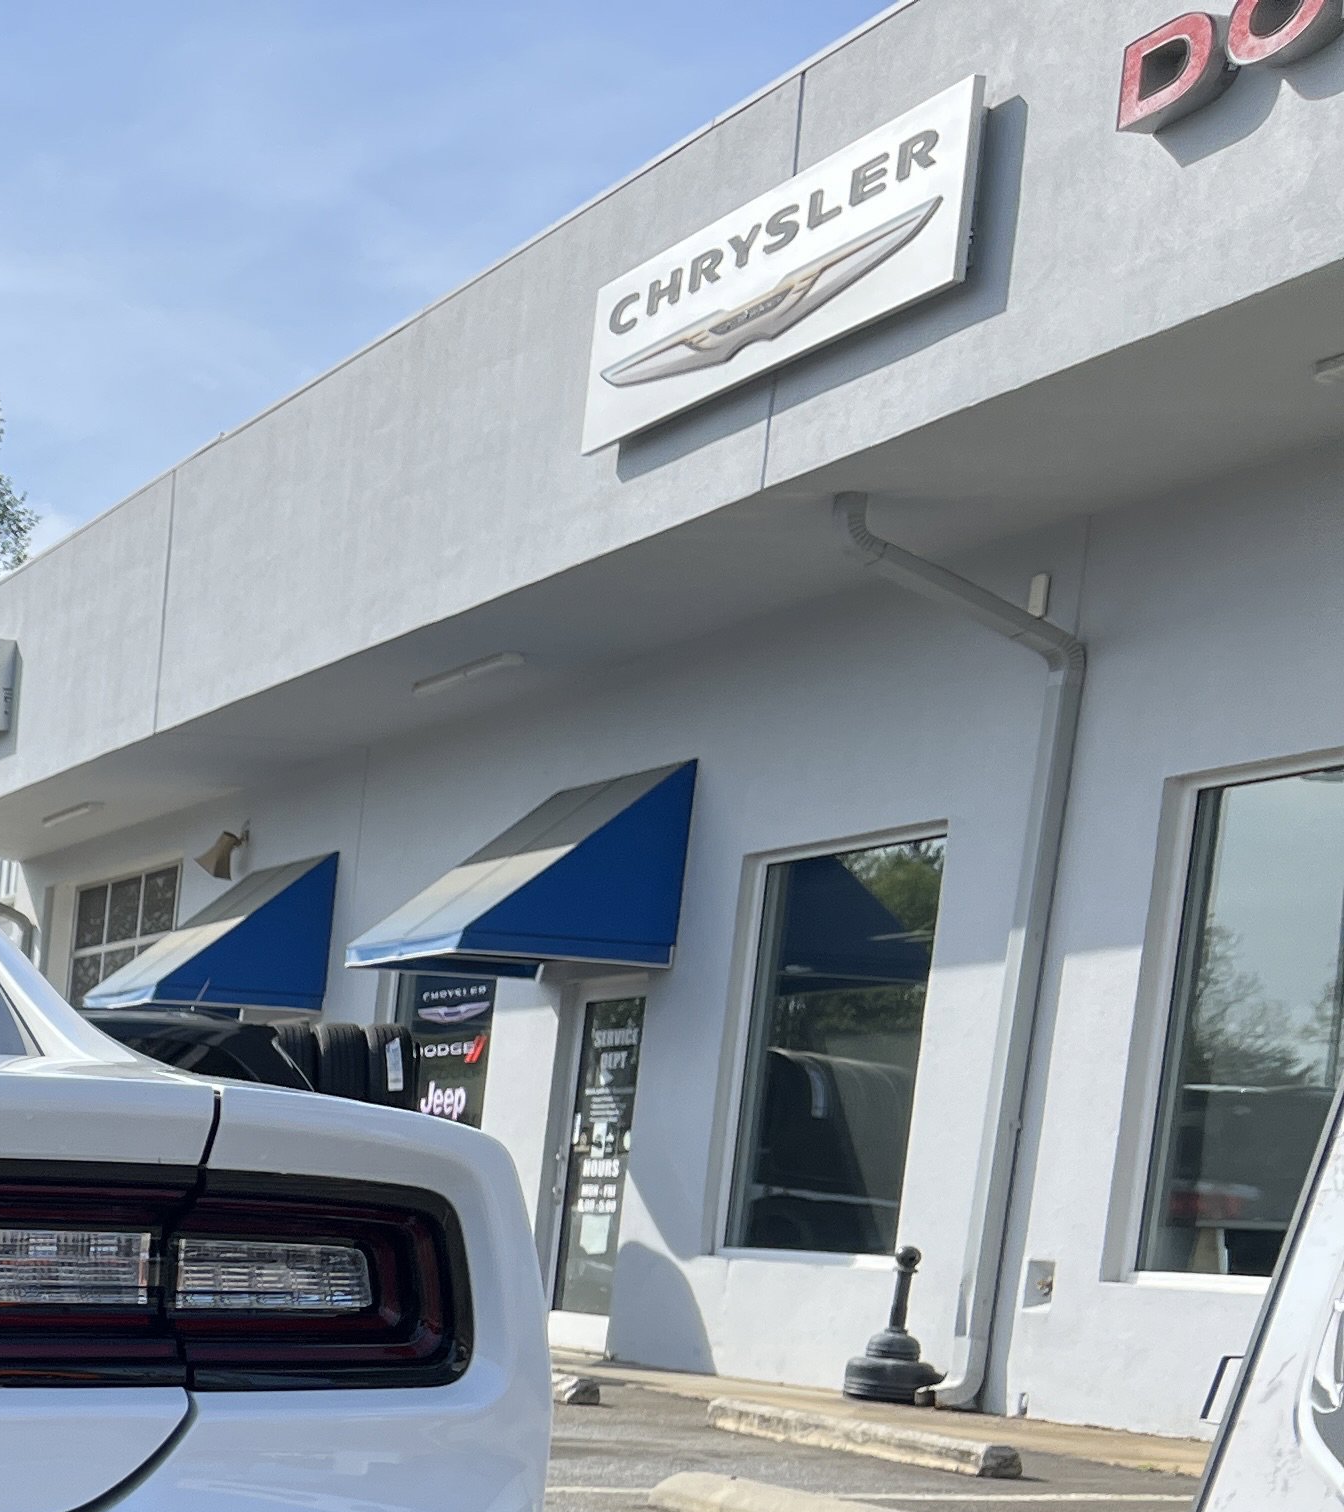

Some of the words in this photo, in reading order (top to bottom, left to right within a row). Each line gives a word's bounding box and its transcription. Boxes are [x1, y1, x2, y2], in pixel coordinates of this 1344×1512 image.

[608, 128, 939, 336] CHRYSLER
[420, 1080, 466, 1121] Jeep
[582, 1158, 620, 1178] HOURS
